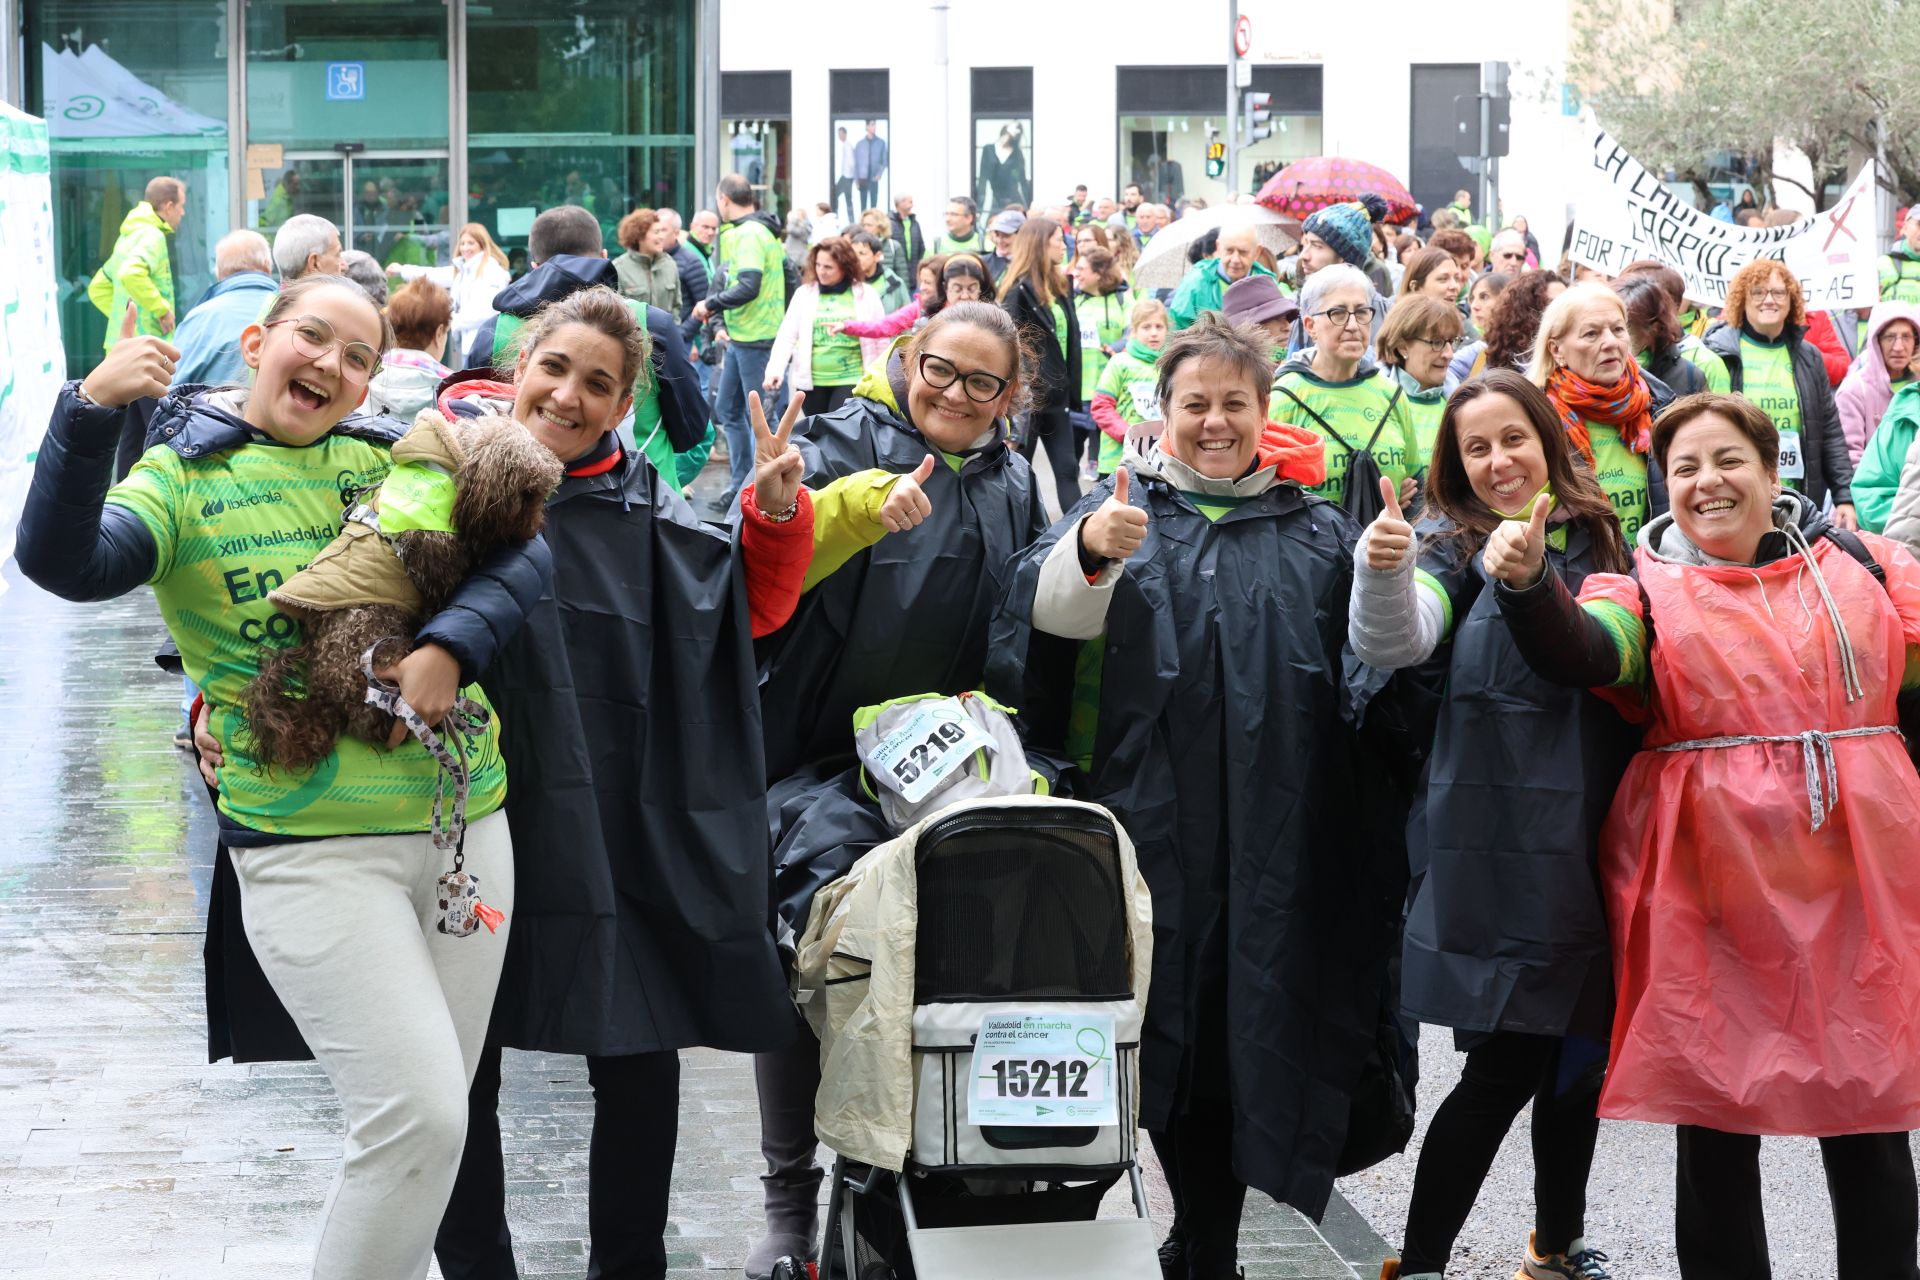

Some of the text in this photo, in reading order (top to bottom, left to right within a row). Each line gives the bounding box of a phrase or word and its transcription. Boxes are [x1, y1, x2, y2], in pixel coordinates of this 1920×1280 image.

[1574, 229, 1613, 267] POR
[1704, 278, 1730, 300] PO
[1761, 396, 1796, 410] mar
[1779, 451, 1797, 466] 95
[226, 489, 283, 511] Iberdrola
[217, 540, 249, 557] XIII
[250, 523, 335, 549] Valladolid
[223, 566, 284, 605] En
[985, 1030, 1049, 1039] contra el cáncer
[988, 1020, 1021, 1029] Valladolid
[1037, 1021, 1072, 1030] marcha
[992, 1059, 1089, 1098] 15212
